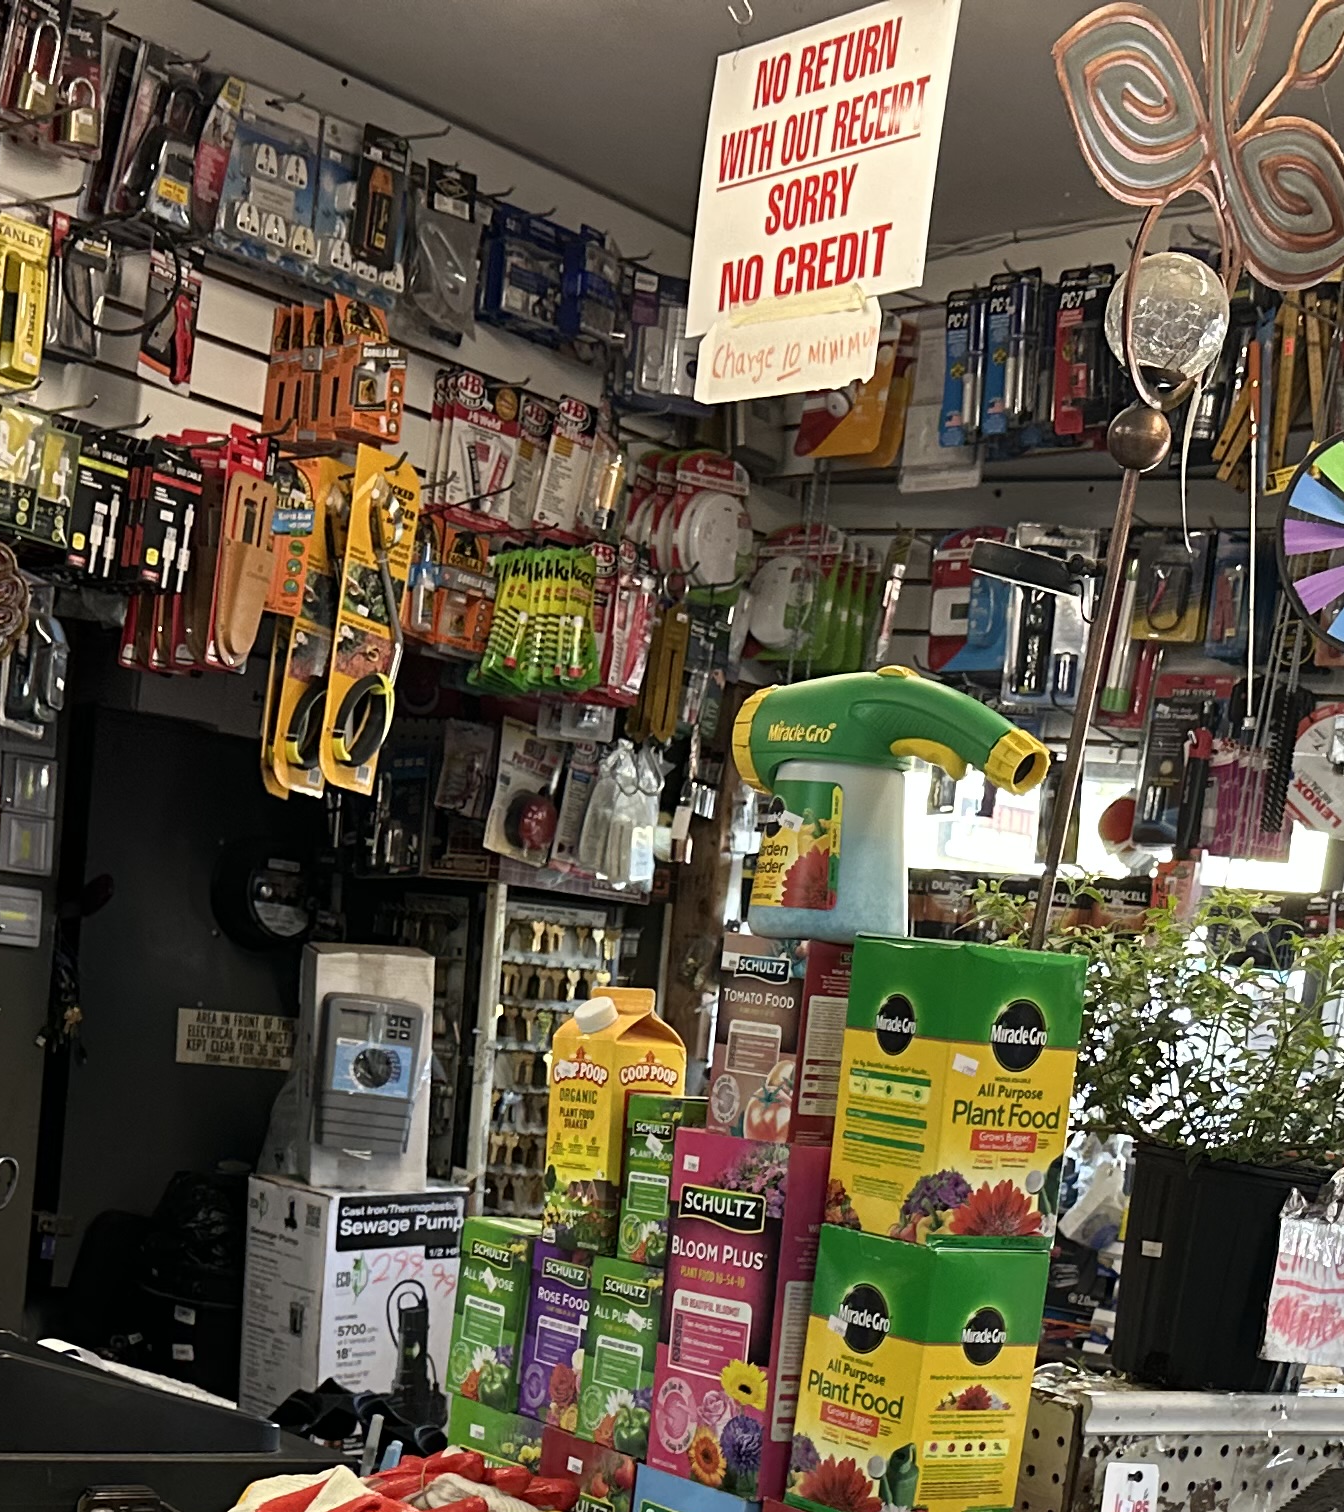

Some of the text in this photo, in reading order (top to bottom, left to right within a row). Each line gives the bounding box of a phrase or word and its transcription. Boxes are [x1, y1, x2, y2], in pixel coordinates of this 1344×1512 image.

[753, 16, 903, 111] NO RETURN
[719, 75, 931, 184] WITH OUT RECEIPT
[765, 163, 858, 236] SORRY
[718, 222, 893, 313] NO CREDIT
[712, 338, 775, 384] Charge
[767, 719, 837, 744] Miracle-Gro
[1293, 777, 1343, 830] LENOX
[738, 957, 786, 975] SCHULTZ
[724, 988, 795, 1009] TOMATO FOOD
[196, 1011, 259, 1028] AREA FRONT
[186, 1038, 255, 1055] KEPT CLEAR FOR
[187, 1024, 289, 1045] ELECTRICAL PANEL MUST
[991, 1023, 1048, 1047] Miracle-Gro
[620, 1060, 679, 1086] COOP POOP
[559, 1087, 598, 1105] ORGANIC
[977, 1083, 1044, 1103] All Purpose
[952, 1100, 1061, 1130] Plant Food
[634, 1120, 673, 1139] SCHULTZ
[978, 1131, 1005, 1143] Grows
[342, 1205, 365, 1217] Cast
[683, 1191, 758, 1221] SCHULTZ
[340, 1213, 465, 1237] Sewage Pump
[472, 1242, 511, 1263] SCHULTZ
[671, 1234, 764, 1271] BLOOM PLUS
[463, 1265, 480, 1281] ALL
[545, 1260, 584, 1284] SCHULTZ
[538, 1286, 590, 1313] ROSE FOOD
[604, 1278, 649, 1301] SCHULTZ
[594, 1304, 614, 1321] ALL
[839, 1302, 891, 1334] Miracle-Gro
[337, 1323, 367, 1338] 5700
[826, 1357, 886, 1389] All Purpose
[808, 1368, 905, 1420] Plant Food
